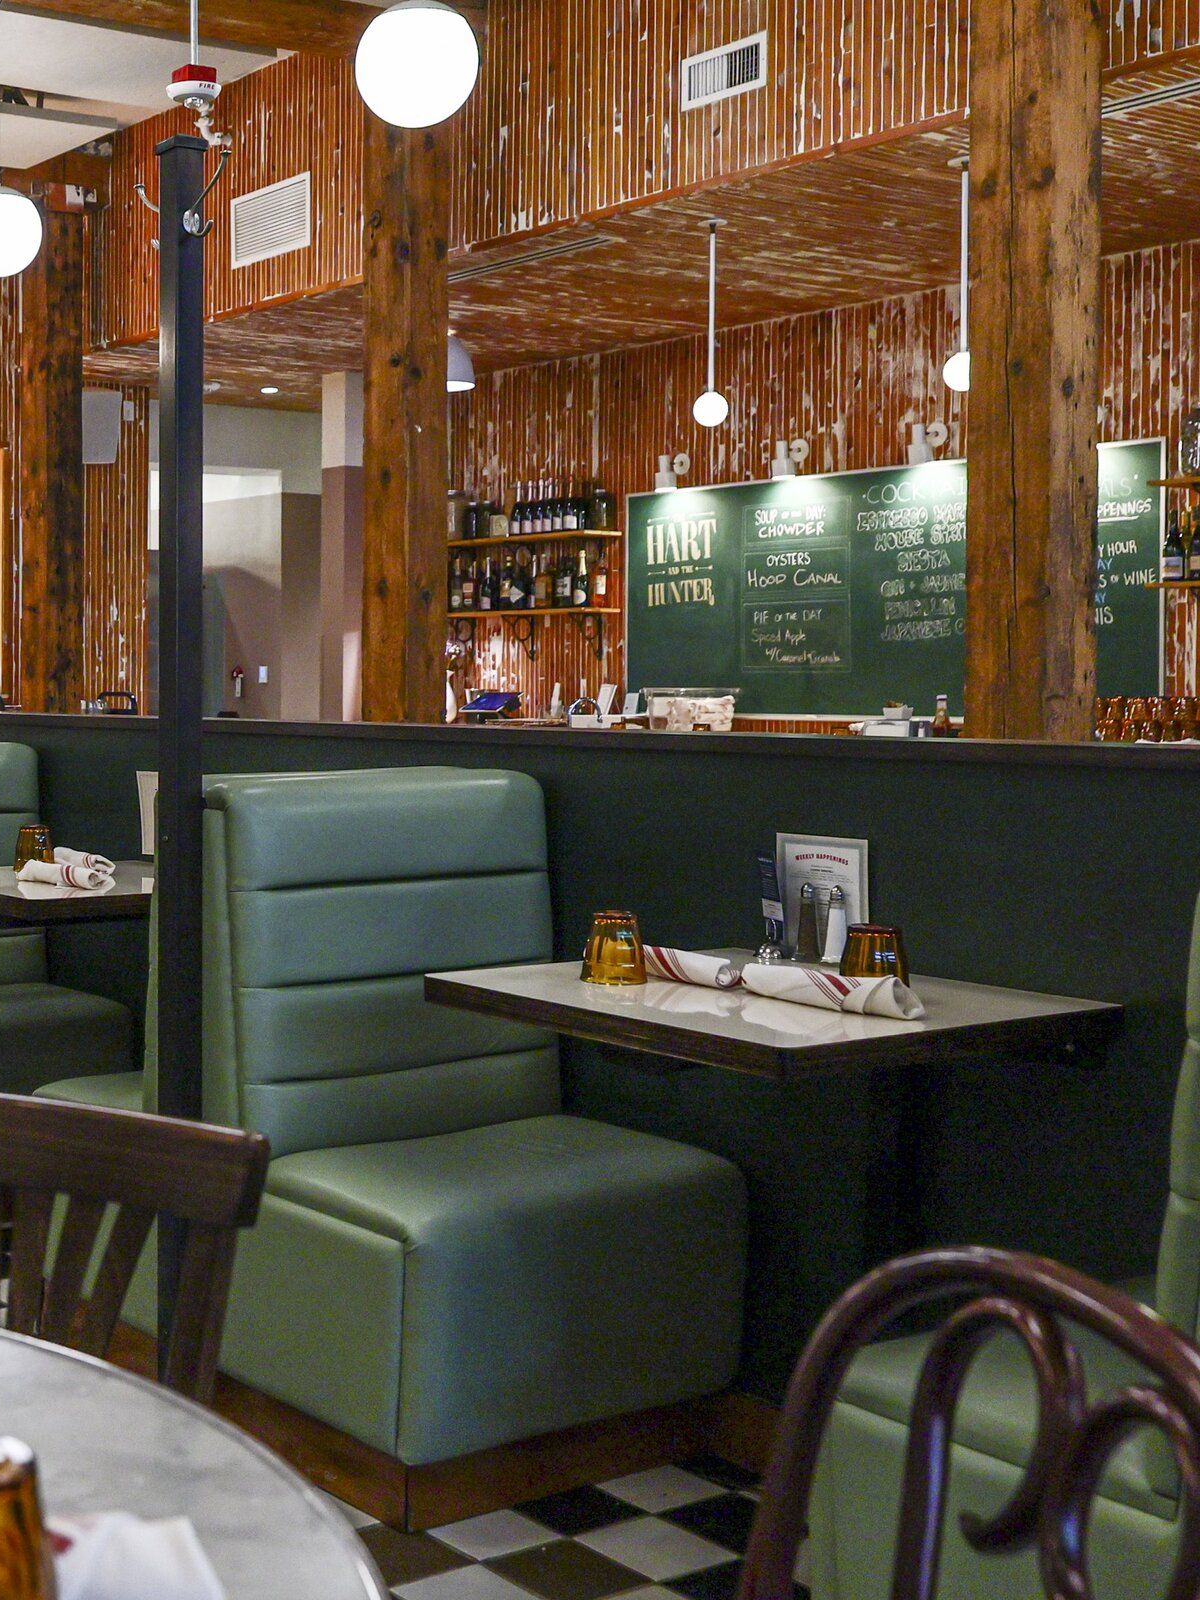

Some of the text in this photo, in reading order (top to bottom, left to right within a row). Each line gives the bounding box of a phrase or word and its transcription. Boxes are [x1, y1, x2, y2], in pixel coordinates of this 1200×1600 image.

[867, 476, 966, 503] COCKTAI
[755, 508, 778, 526] SOUP
[1097, 498, 1152, 517] PPENINGS
[857, 507, 928, 531] ESPRESSO
[758, 521, 825, 538] CHOWDER
[646, 519, 717, 565] HART
[875, 528, 924, 551] HOUSE
[1107, 539, 1137, 557] HOUR
[766, 552, 811, 567] OYSTERS
[897, 549, 951, 572] SIESTA
[747, 568, 842, 587] HOOD CANAL
[1124, 568, 1157, 586] WINE
[647, 578, 715, 606] HUNTER
[803, 608, 822, 621] DAY
